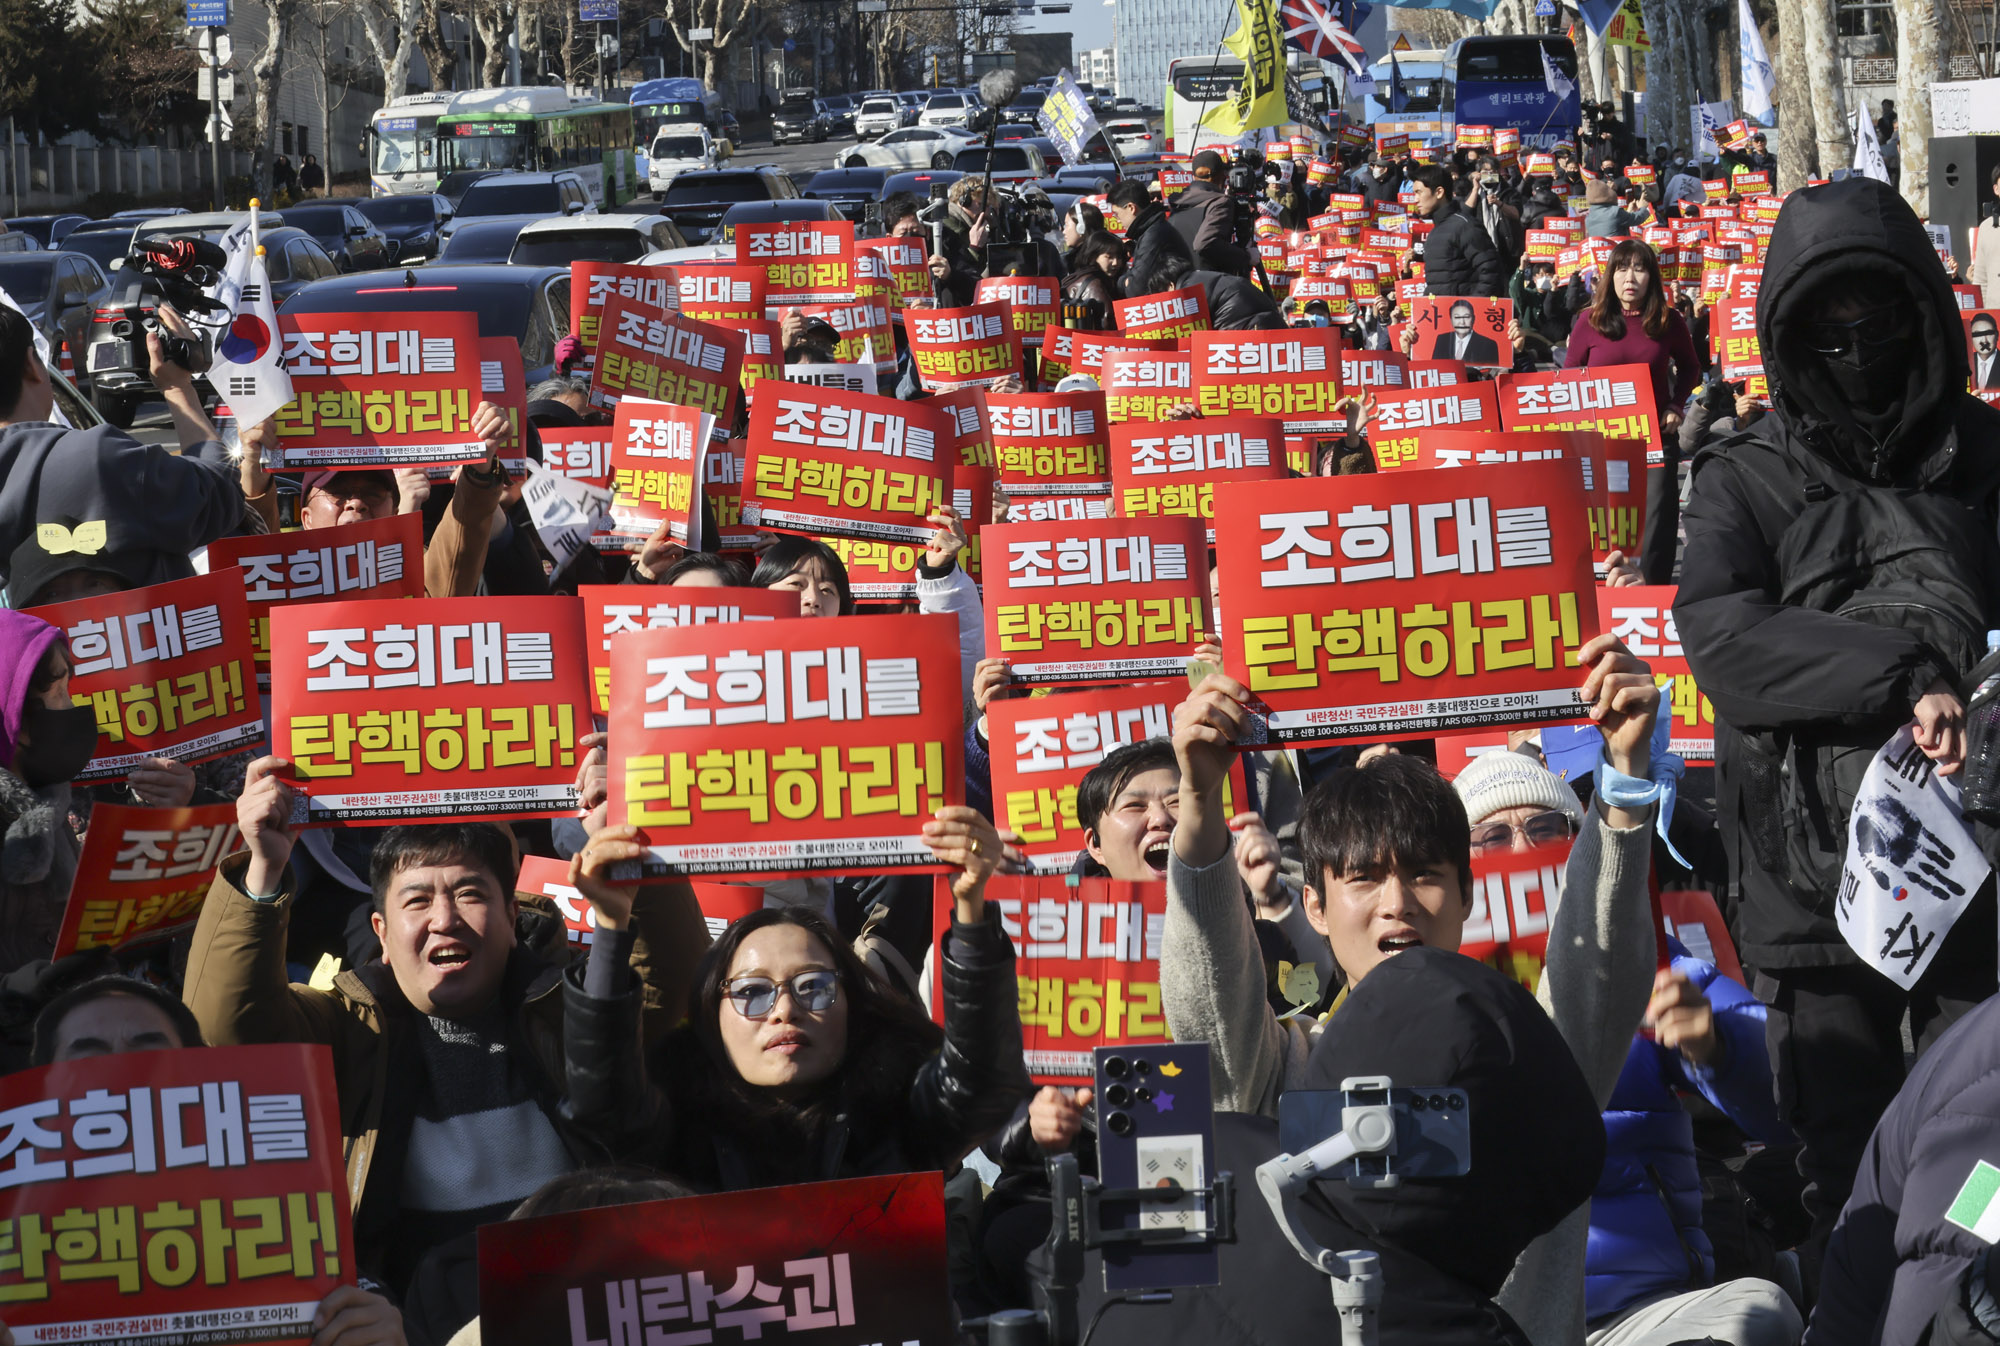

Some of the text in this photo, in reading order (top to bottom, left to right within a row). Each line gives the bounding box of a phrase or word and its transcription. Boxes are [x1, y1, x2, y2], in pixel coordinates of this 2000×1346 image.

[650, 105, 680, 116] 740
[1489, 92, 1546, 105] 엘리트관광
[1164, 172, 1194, 184] 조희대
[1736, 174, 1764, 184] 조희대를
[1548, 220, 1582, 230] 조희대를
[1704, 209, 1733, 218] 조희대를
[749, 231, 841, 258] 조희대를
[1370, 235, 1408, 247] 조희대를
[1530, 233, 1566, 244] 조희대를
[1704, 245, 1740, 260] 조희대를
[680, 276, 752, 303] 희대를
[766, 263, 848, 289] 핵하라!
[1295, 282, 1346, 296] 조희대를
[914, 314, 1003, 344] 조희대를
[1123, 297, 1200, 328] 조희대를
[1417, 306, 1506, 332] 사 형
[284, 330, 456, 376] 조희대를
[615, 310, 726, 373] 조희대를
[1207, 341, 1326, 375] 조희대를
[916, 343, 1013, 376] 탄핵하라!
[1112, 361, 1190, 388] 조희대
[1342, 360, 1402, 386] 희대를
[601, 351, 728, 419] 탄핵하라!
[1200, 381, 1336, 416] 탄핵하라!
[1516, 378, 1637, 416] 조희대를
[274, 389, 469, 436] 탄핵하라!
[987, 406, 1095, 438] 조희대를
[1378, 395, 1482, 431] 조희대를
[772, 399, 935, 462] 조희대를
[996, 444, 1105, 477] 핵하라!
[1131, 432, 1270, 476] 조희대를
[755, 454, 944, 516] 탄핵하라!
[1259, 496, 1553, 588] 조희대를
[238, 540, 404, 602] 조희대를
[1008, 536, 1188, 588] 조희대를
[66, 604, 223, 676] 희대를
[997, 597, 1205, 652] 탄핵하라!
[306, 622, 554, 692] 조희대를
[1242, 592, 1582, 692] 탄핵하라!
[1155, 658, 1178, 668] 모이자!
[72, 660, 245, 742] 핵하라!
[643, 646, 920, 729] 조희대를
[1305, 695, 1539, 724] 내란청산! 국민주권실현! 촛불대행진으로 모이자!
[197, 734, 220, 749] 모이자!
[290, 704, 575, 778] 탄핵하라!
[1014, 704, 1173, 774] 조희대
[1278, 730, 1293, 739] 후원
[1300, 727, 1315, 737] 신한
[1317, 723, 1378, 736] 100-036-551308
[1378, 718, 1438, 730] 촛불승리전환행동
[1445, 716, 1460, 725] ARS
[341, 788, 539, 807] 내란청산! 국민주권실현! 촛불대행진으로 모이자!
[625, 740, 944, 827] 탄핵하라!
[336, 810, 349, 818] 신한
[350, 808, 402, 818] 100-036-551308
[868, 839, 903, 852] 모이자!
[0, 1080, 309, 1190] 조희대를
[0, 1191, 341, 1300] 탄핵하라!
[566, 1252, 856, 1346] 내란수괴
[34, 1306, 298, 1342] 내란청산! 국민주권실현! 촛불대행진으로 모이자!
